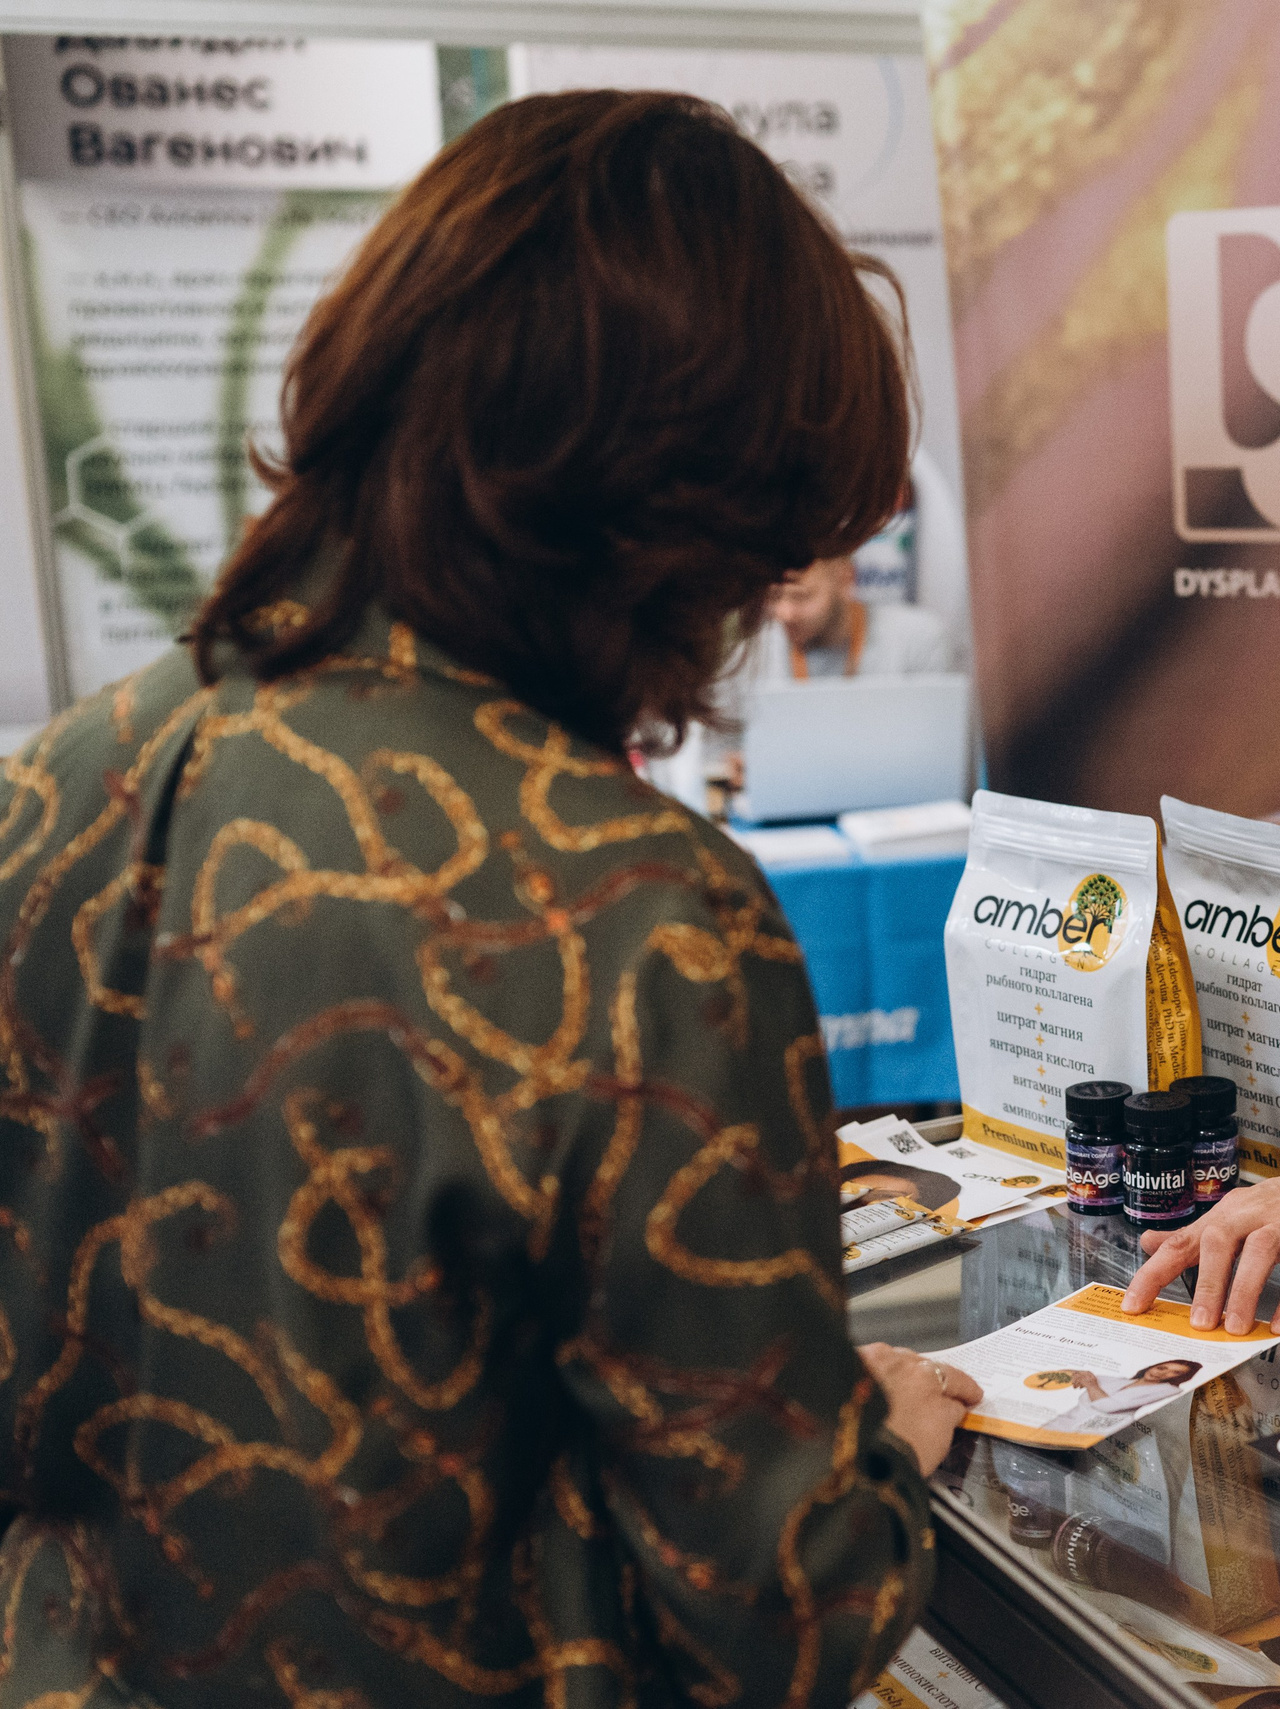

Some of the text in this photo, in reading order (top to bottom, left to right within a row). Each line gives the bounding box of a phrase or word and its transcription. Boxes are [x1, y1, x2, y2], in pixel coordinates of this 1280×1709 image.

[60, 64, 272, 110] Ованес
[68, 121, 370, 168] Вагенович
[973, 894, 1113, 945] amber
[986, 973, 1093, 1008] рыбного коллагена
[1019, 966, 1057, 984] гидрат
[1169, 967, 1186, 1018] developed
[1195, 980, 1240, 1003] рыбного
[1226, 974, 1263, 993] гидрат
[1155, 962, 1168, 1005] Alevtina,
[1162, 1008, 1175, 1031] PhD
[997, 1011, 1083, 1042] цитрат магния
[1206, 1017, 1247, 1041] цитрат
[989, 1038, 1095, 1075] янтарная кислота
[1012, 1074, 1062, 1098] витамин
[982, 1123, 1038, 1153] Premium
[1039, 1142, 1065, 1160] fish
[1253, 1149, 1278, 1169] fish
[928, 1648, 977, 1685] витамин
[876, 1687, 903, 1709] fish
